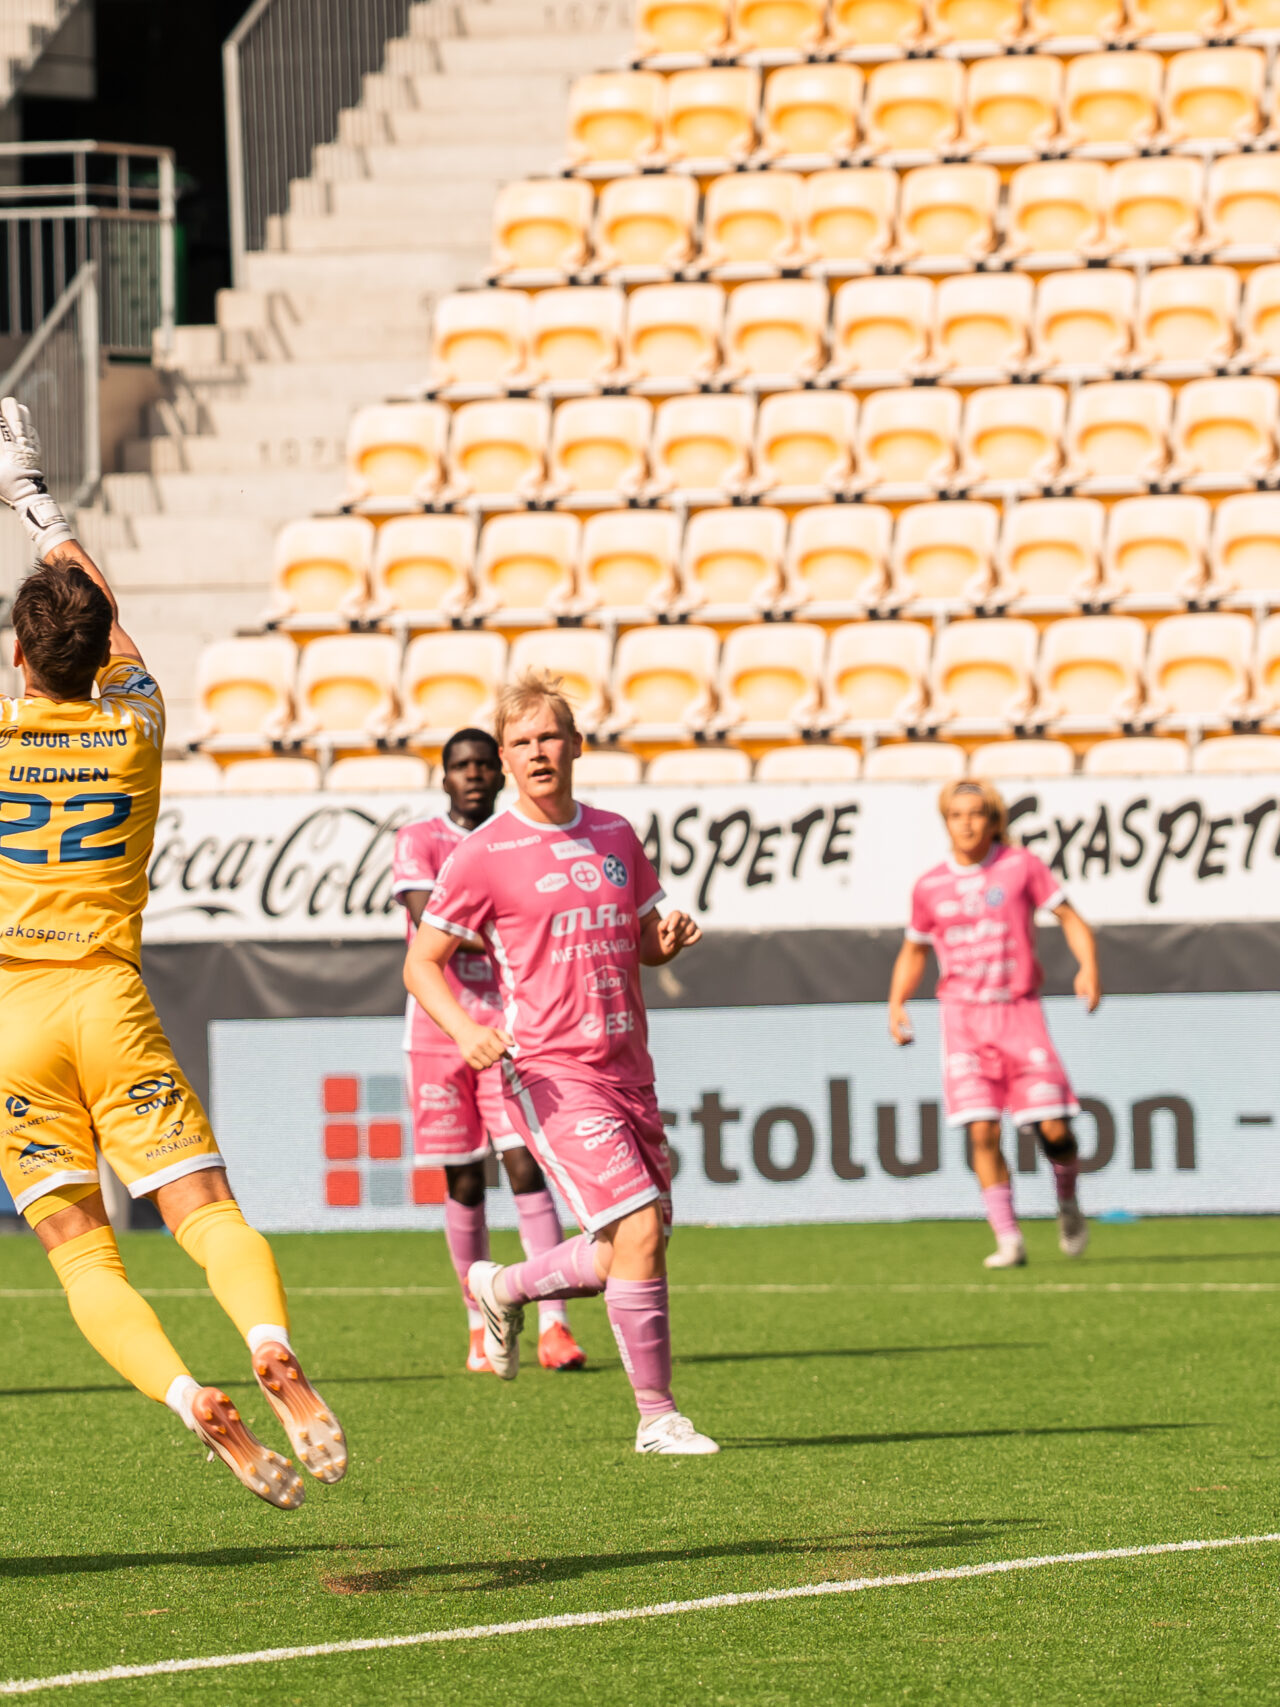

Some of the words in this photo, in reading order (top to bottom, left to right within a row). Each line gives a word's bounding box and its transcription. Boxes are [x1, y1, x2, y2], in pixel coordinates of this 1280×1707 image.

[21, 729, 127, 748] SUUR-SAVO
[9, 765, 109, 782] URONEN
[146, 1134, 204, 1161] MARSKIDATA
